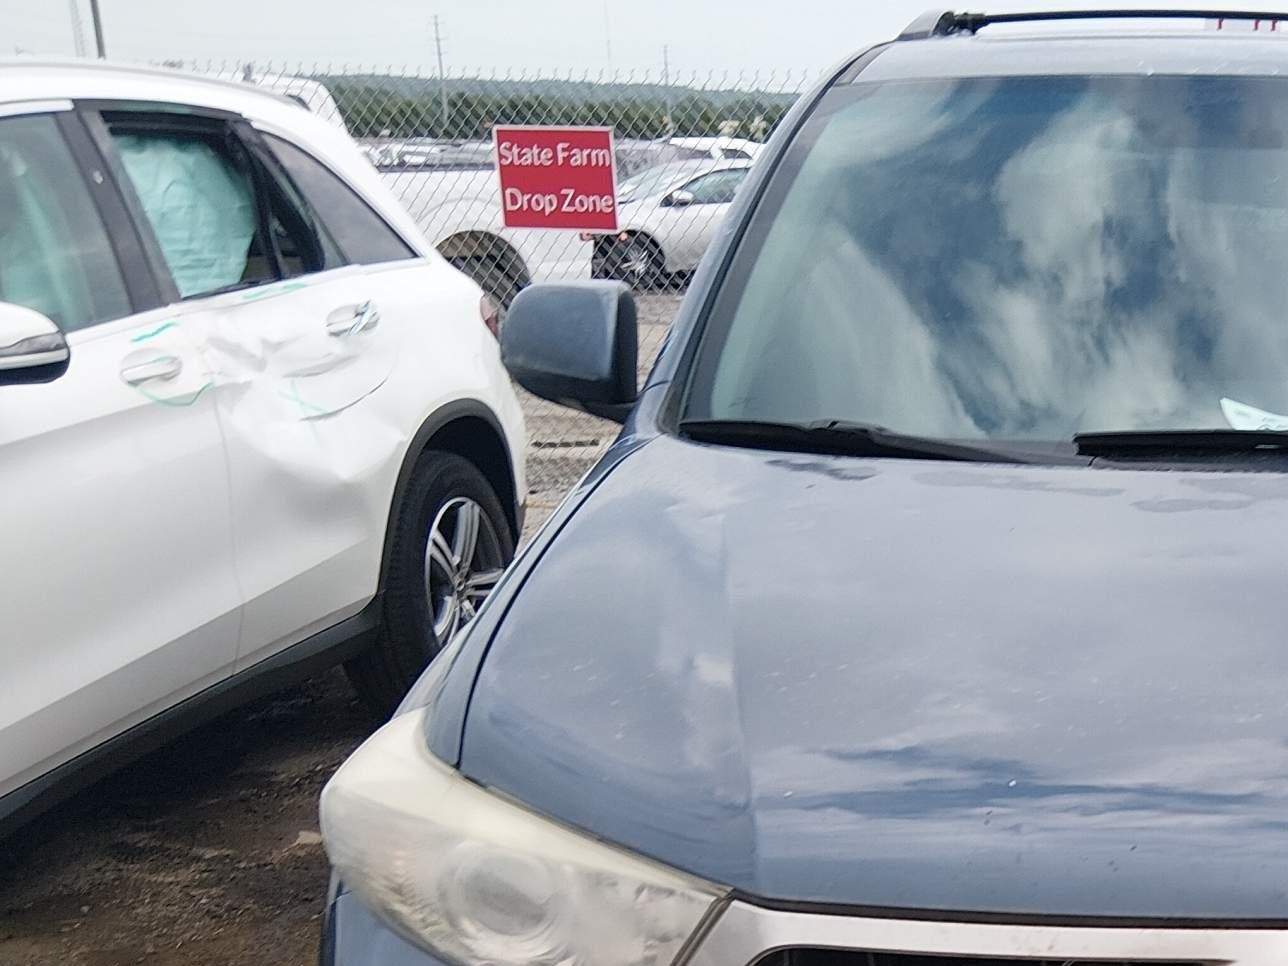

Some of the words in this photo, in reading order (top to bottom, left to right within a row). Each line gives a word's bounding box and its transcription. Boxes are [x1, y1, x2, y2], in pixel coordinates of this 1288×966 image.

[500, 142, 553, 166] State
[557, 143, 610, 167] Farm
[505, 187, 557, 216] Drop
[561, 188, 614, 213] Zone
